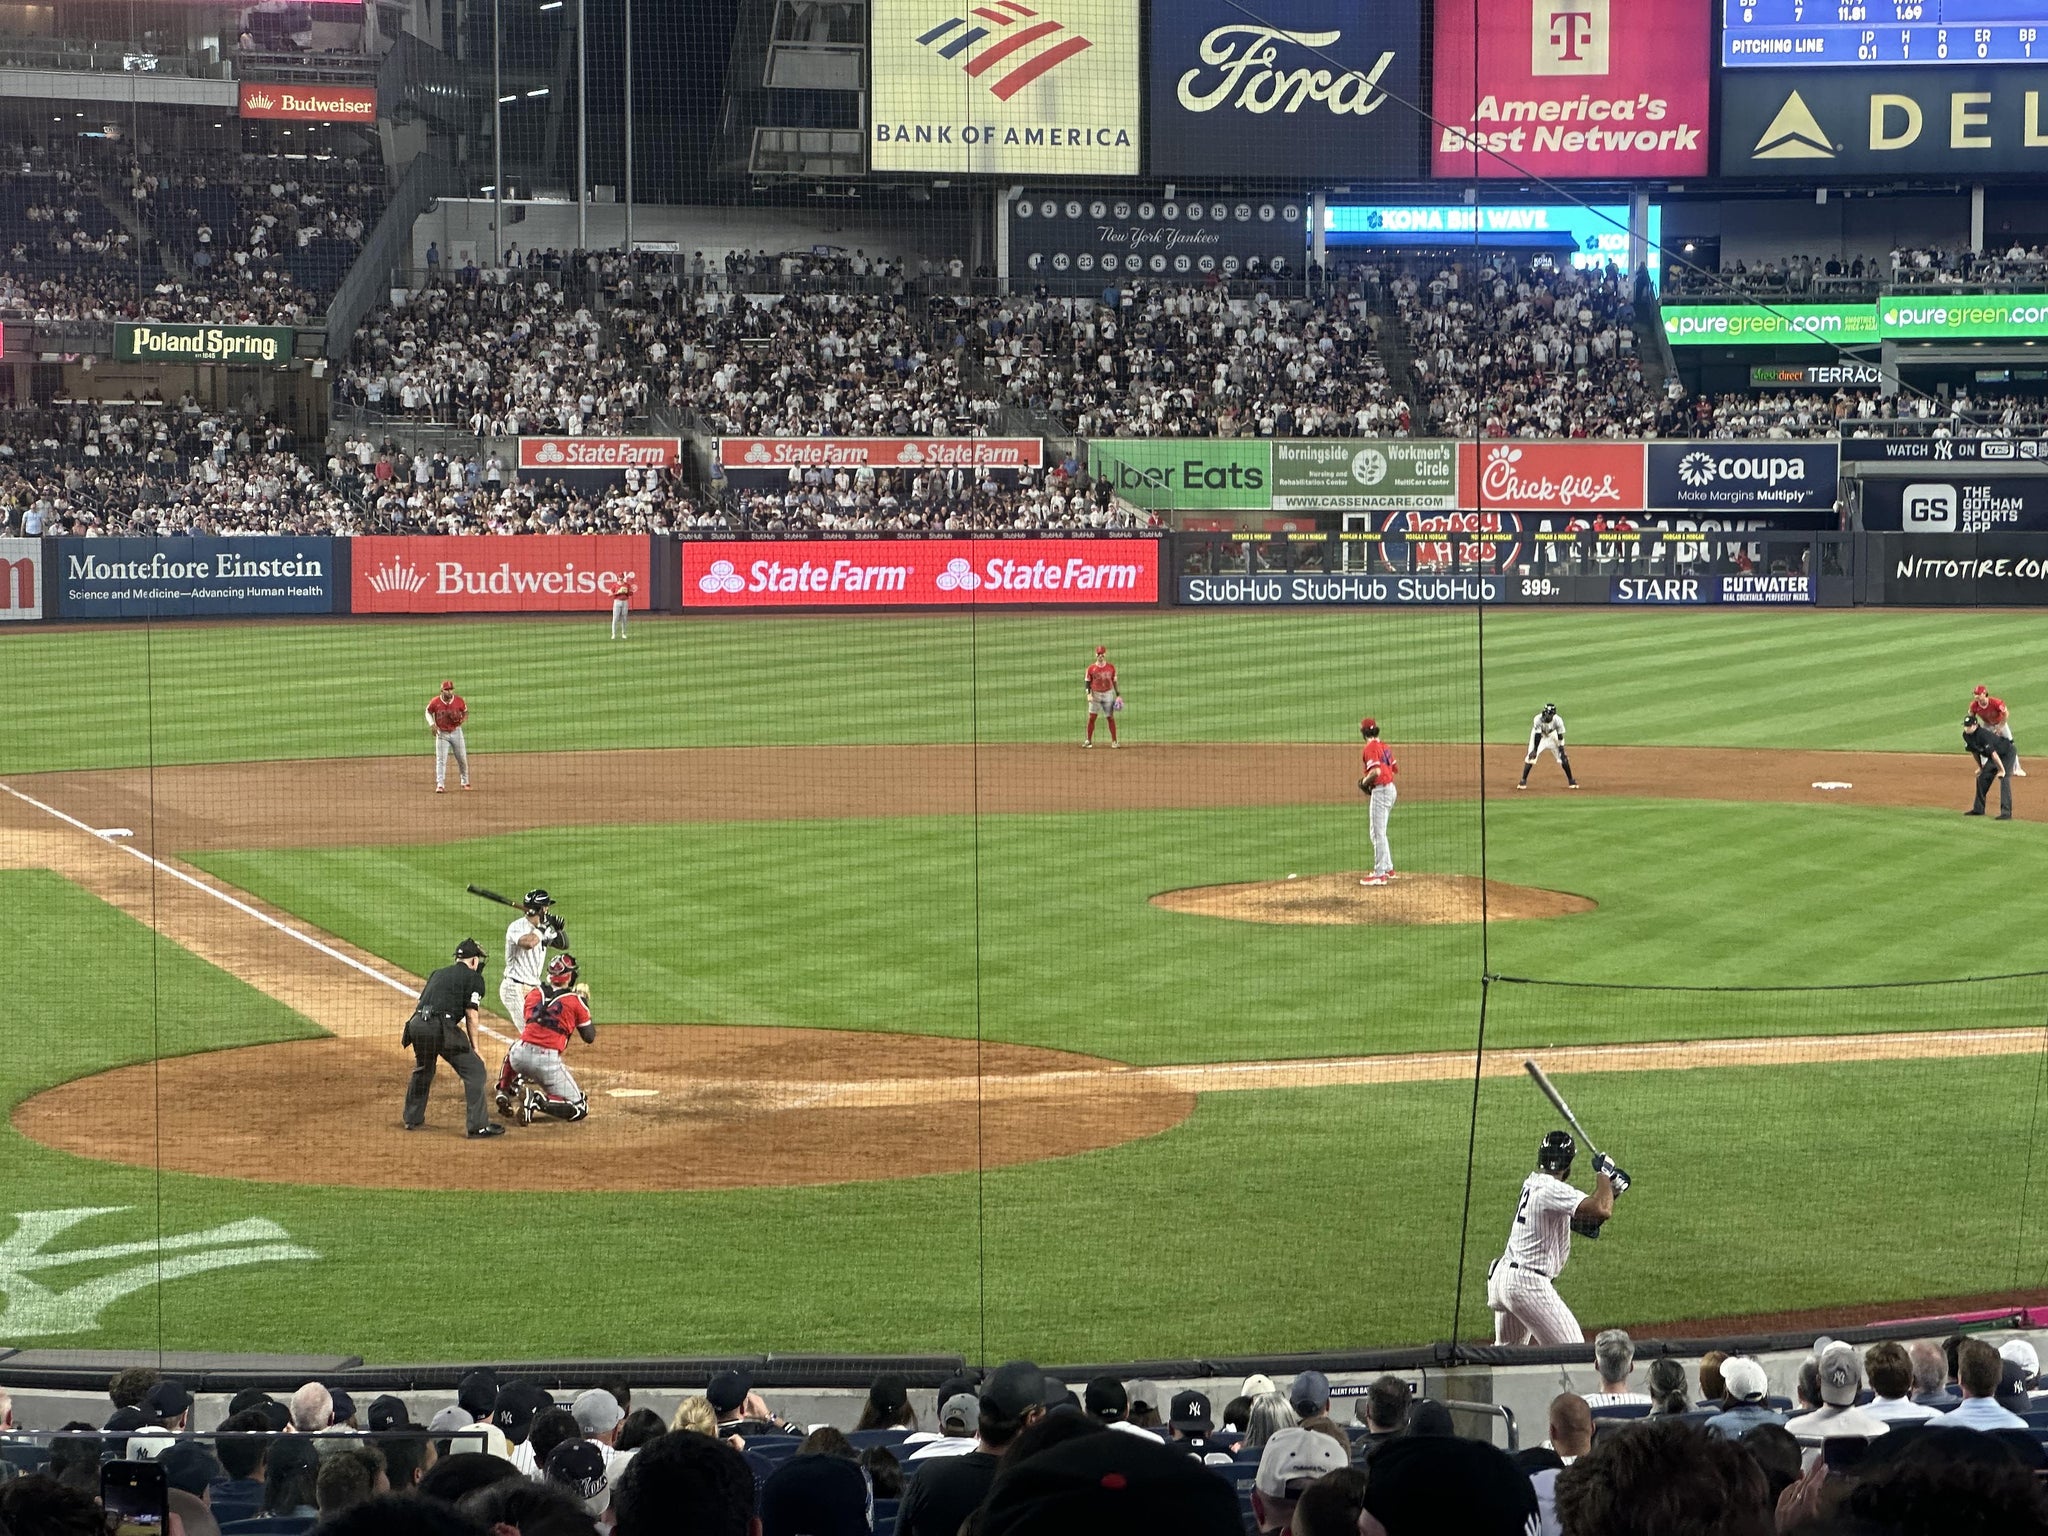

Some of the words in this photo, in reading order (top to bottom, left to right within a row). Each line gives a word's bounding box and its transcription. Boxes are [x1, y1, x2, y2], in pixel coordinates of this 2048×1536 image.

[1795, 8, 1803, 22] 7
[1838, 7, 1866, 21] 11.81
[1896, 6, 1923, 20] 1.69
[1861, 31, 1875, 44] IP
[1901, 30, 1911, 43] H
[1938, 30, 1947, 42] R
[1974, 30, 1991, 43] ER
[2019, 29, 2037, 42] BB
[1732, 40, 1792, 54] PITCHING
[1795, 39, 1824, 53] LINE
[1858, 45, 1877, 60] 0.1
[1903, 46, 1909, 59] 1
[1937, 44, 1948, 59] 0
[1977, 44, 1988, 58] 0
[2024, 43, 2031, 58] 1
[1177, 24, 1396, 115] Ford
[281, 94, 372, 113] Budweiser
[1471, 94, 1667, 122] America's
[877, 124, 952, 143] BANK
[962, 127, 996, 144] OF
[1004, 127, 1130, 147] AMERICA
[1439, 126, 1526, 152] Best
[1532, 124, 1701, 152] Network
[1117, 206, 1127, 215] 37
[1190, 207, 1199, 216] 16
[1214, 207, 1224, 217] 15
[1238, 208, 1248, 217] 32
[1286, 209, 1296, 218] 10
[1382, 211, 1443, 229] KONA
[1488, 210, 1548, 229] WAVE
[1097, 226, 1128, 242] New
[1130, 227, 1162, 249] York
[1165, 228, 1219, 250] Yankees
[1055, 257, 1066, 267] 44
[1080, 257, 1091, 267] 23
[1103, 258, 1115, 267] 49
[1128, 258, 1139, 267] 42
[1177, 259, 1187, 268] 51
[1201, 260, 1212, 269] 46
[1225, 260, 1237, 269] 20
[1680, 315, 1842, 336] puregreen.com
[132, 328, 204, 354] Poland
[207, 330, 275, 360] Spring
[1754, 367, 1803, 381] freshdirect
[1279, 445, 1348, 463] Morningside
[1388, 445, 1450, 461] Workmen's
[1886, 444, 1928, 456] WATCH
[1959, 444, 1975, 456] ON
[1985, 445, 2010, 455] YES
[1183, 460, 1263, 489] Eats
[1415, 461, 1449, 476] Circle
[1718, 456, 1805, 487] coupa
[1678, 490, 1707, 501] Make
[1710, 490, 1754, 504] Margins
[1963, 486, 1991, 498] THE
[1286, 497, 1443, 507] WWW.CASSENACARE.COM
[1911, 498, 1948, 522] GS
[1963, 498, 2023, 510] GOTHAM
[1963, 510, 2018, 522] SPORTS
[69, 554, 209, 580] Montefiore
[215, 554, 322, 578] Einstein
[69, 590, 109, 599] Science
[112, 589, 130, 599] and
[247, 586, 285, 597] Human
[288, 586, 323, 597] Health
[1190, 579, 1281, 601] StubHub
[1292, 579, 1387, 601] StubHub
[1398, 579, 1495, 600] StubHub
[1521, 579, 1551, 596] 399
[1618, 580, 1698, 600] STARR
[1723, 577, 1808, 592] CUTWATER
[1331, 1387, 1348, 1396] ALERT
[1348, 1387, 1359, 1395] FOR
